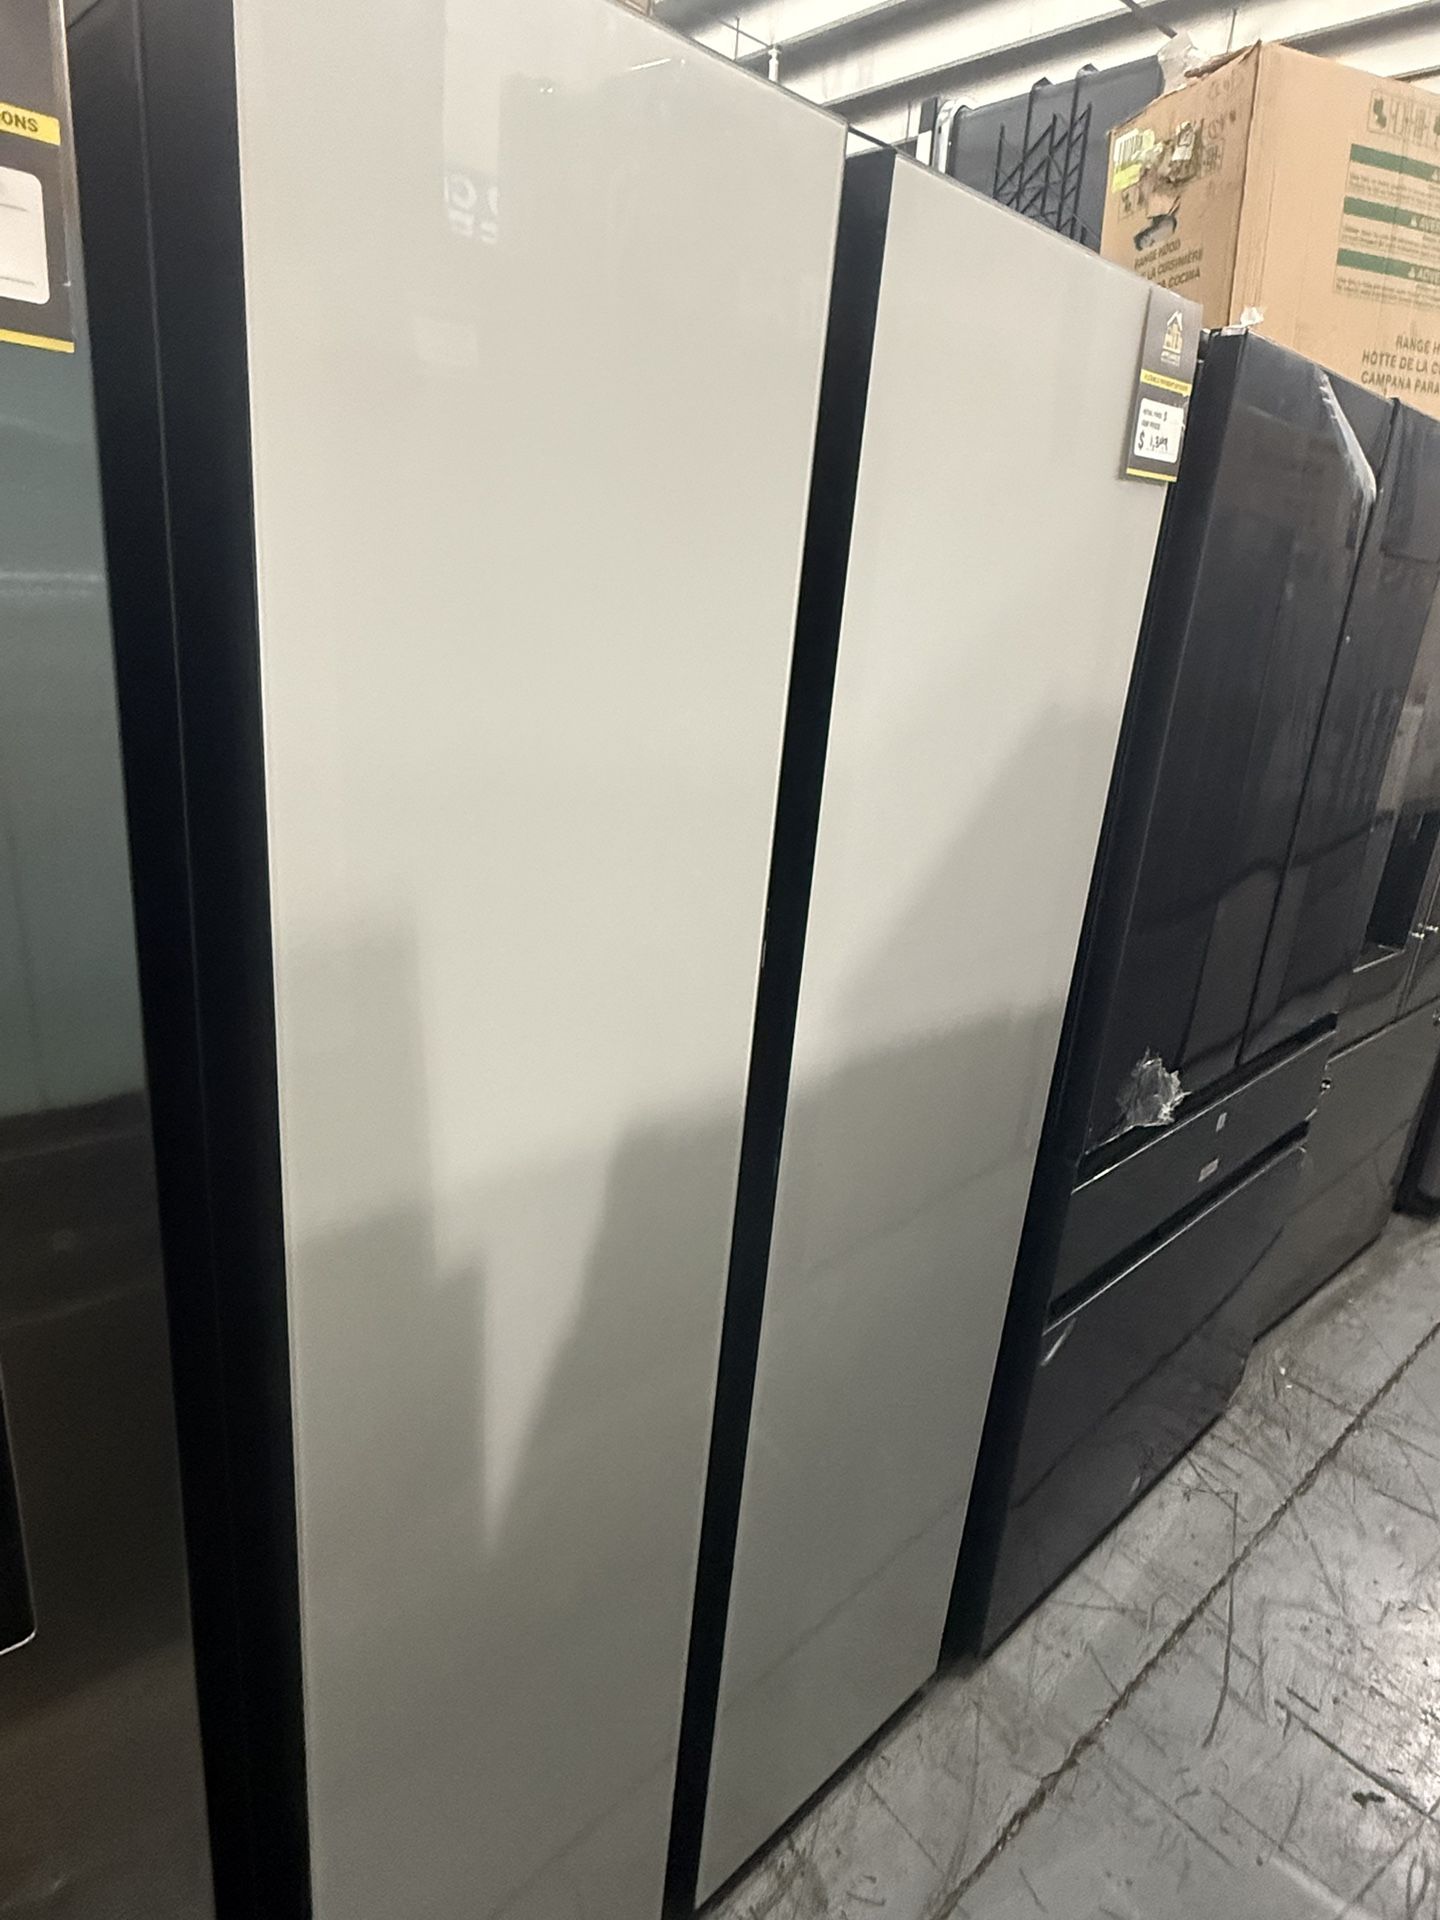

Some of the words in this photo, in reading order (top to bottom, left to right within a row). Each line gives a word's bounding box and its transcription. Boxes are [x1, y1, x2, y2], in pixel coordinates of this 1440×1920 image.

[1396, 335, 1431, 355] RANGE
[1361, 349, 1397, 368] HOTTE
[1399, 356, 1415, 371] DE
[1416, 359, 1428, 374] LA
[1361, 370, 1412, 390] CAMPANA
[1414, 378, 1440, 395] PARA
